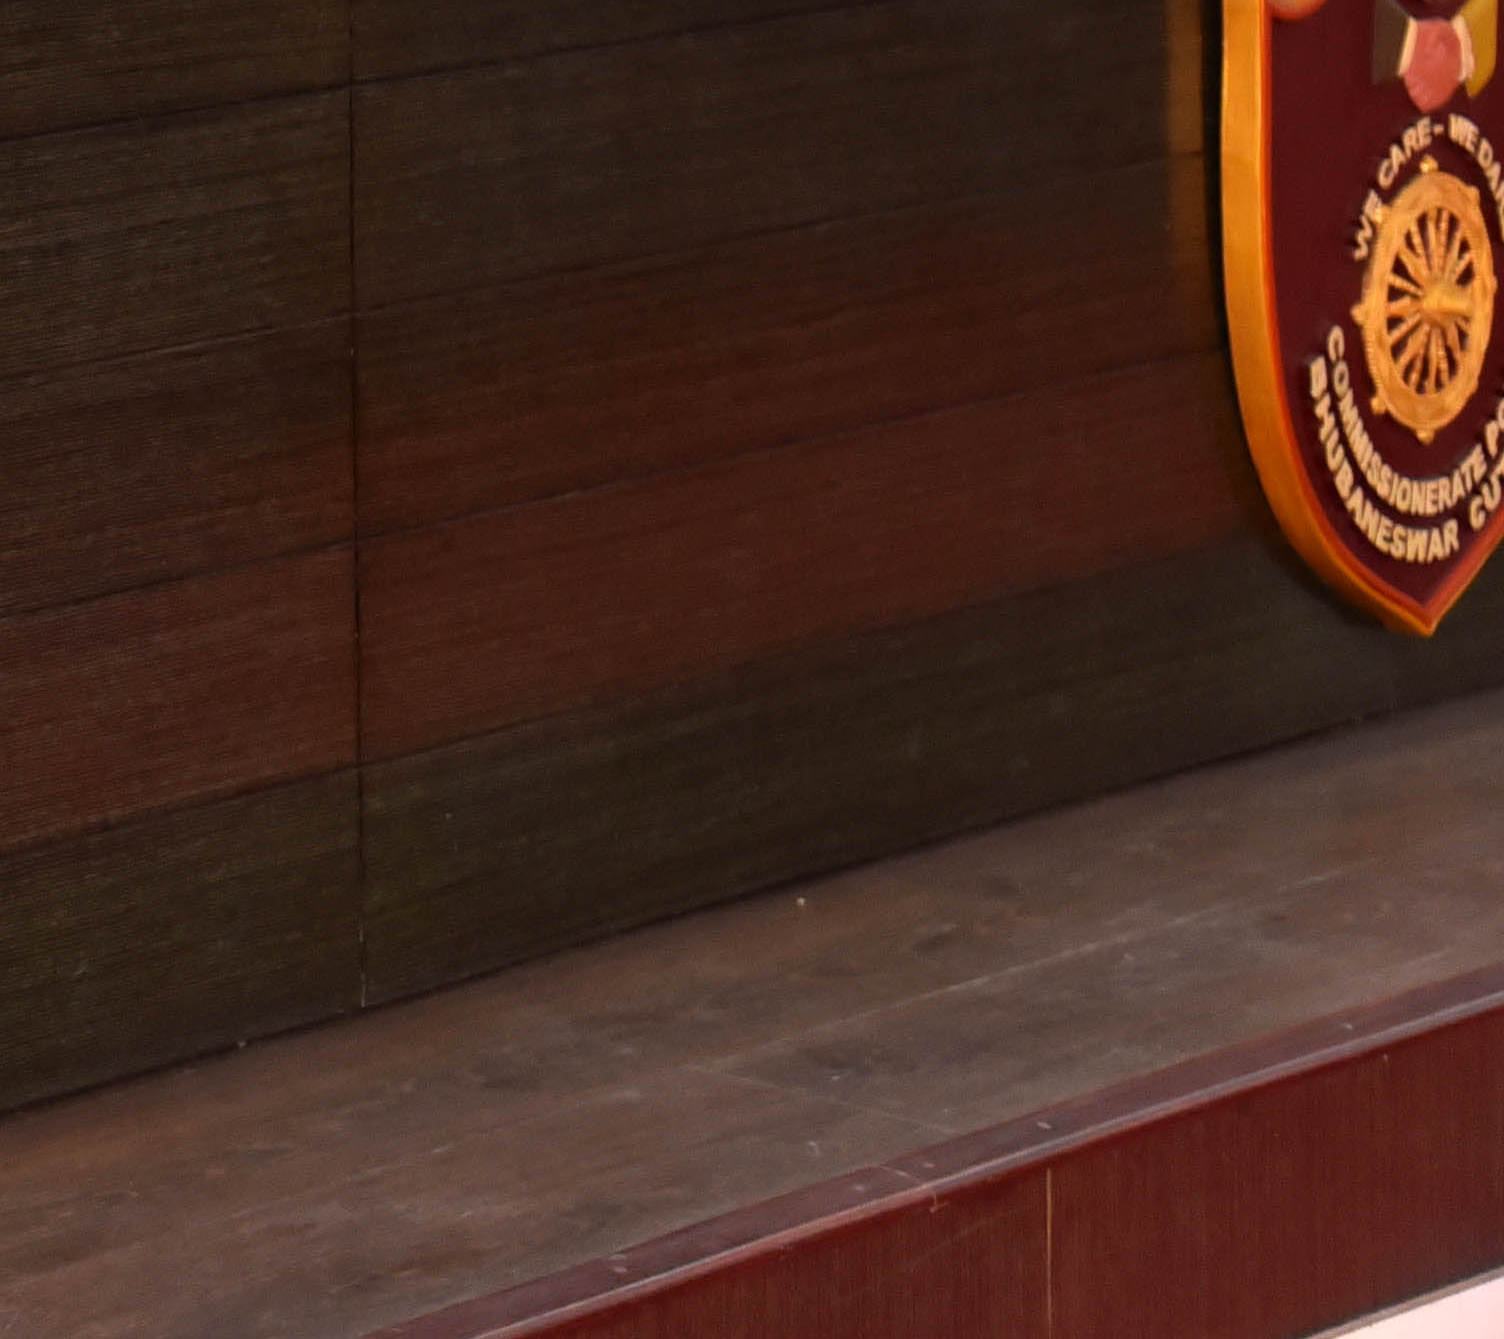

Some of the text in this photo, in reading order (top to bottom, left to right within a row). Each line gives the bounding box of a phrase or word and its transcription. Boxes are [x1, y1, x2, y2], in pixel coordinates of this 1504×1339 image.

[1377, 115, 1433, 189] CARE
[1310, 355, 1460, 563] BHUBANESWAR
[1327, 324, 1488, 516] COMMISSIONERATE
